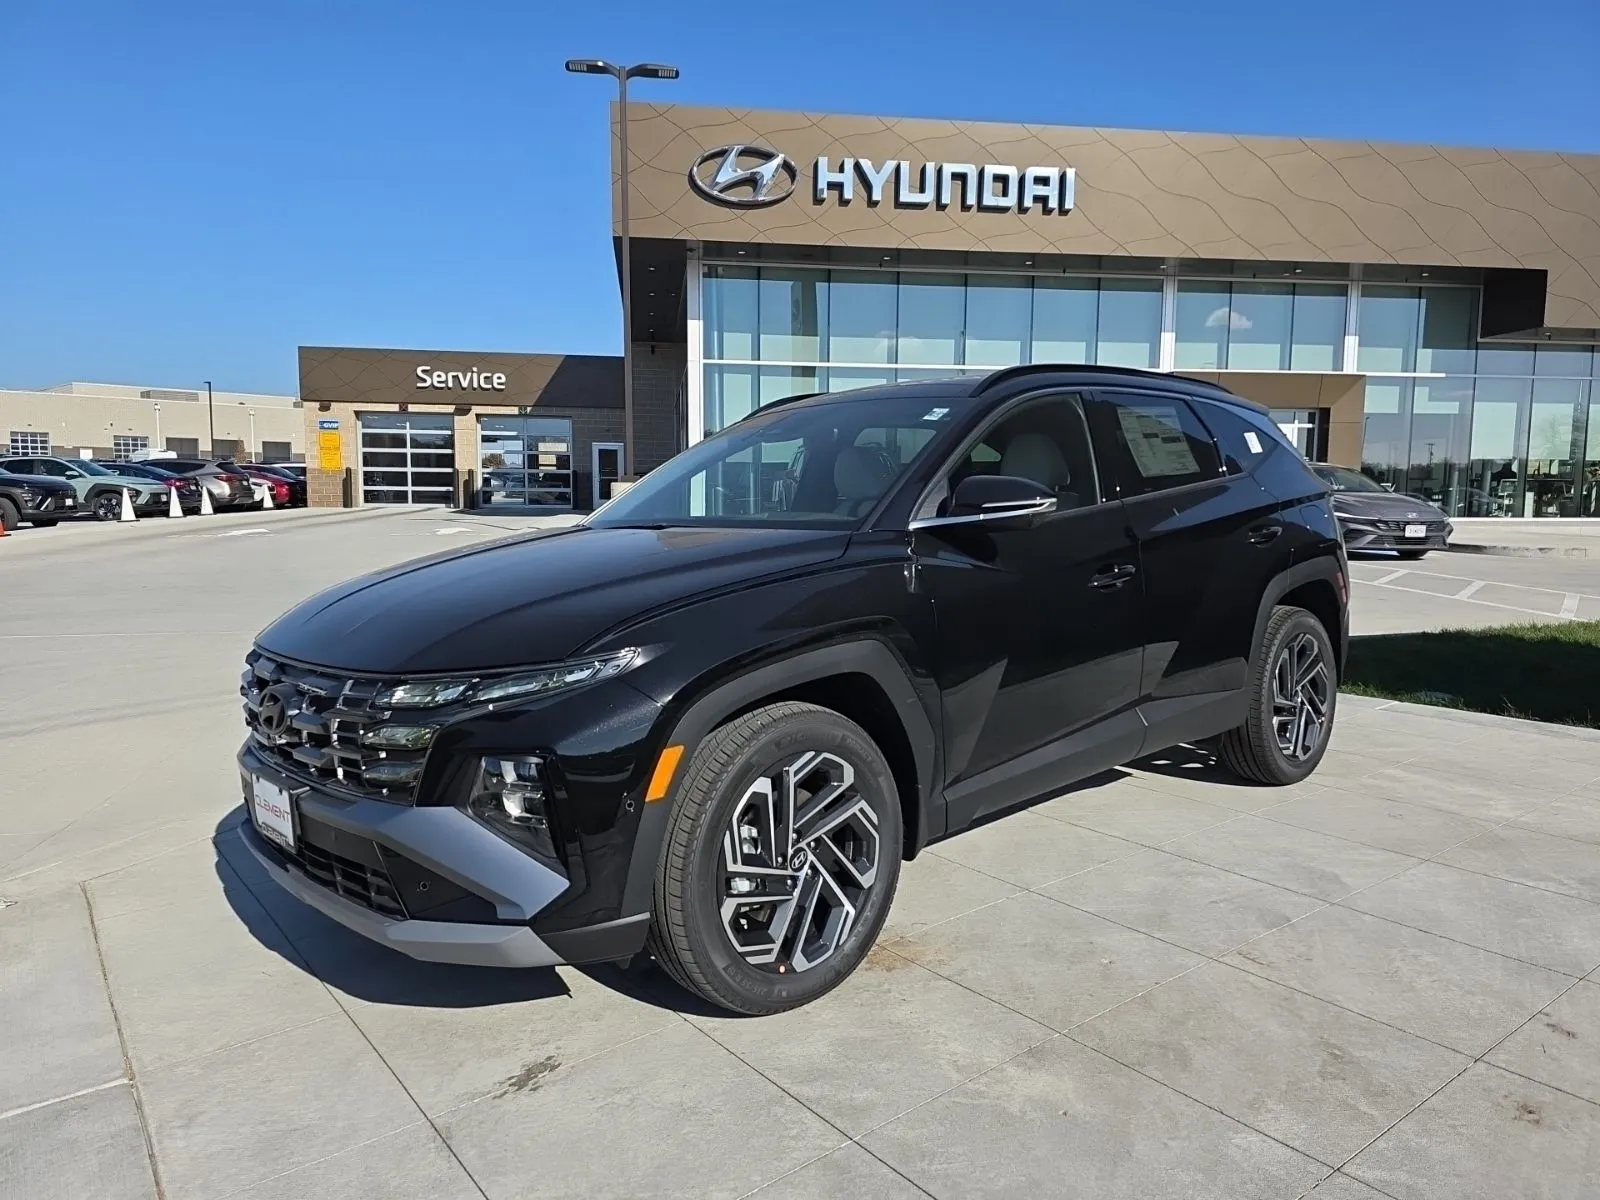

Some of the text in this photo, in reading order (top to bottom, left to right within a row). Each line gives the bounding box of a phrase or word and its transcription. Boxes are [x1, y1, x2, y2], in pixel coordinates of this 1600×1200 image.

[814, 156, 1076, 214] HYUNDAI
[416, 365, 506, 390] Service
[254, 794, 290, 823] CLEMENT
